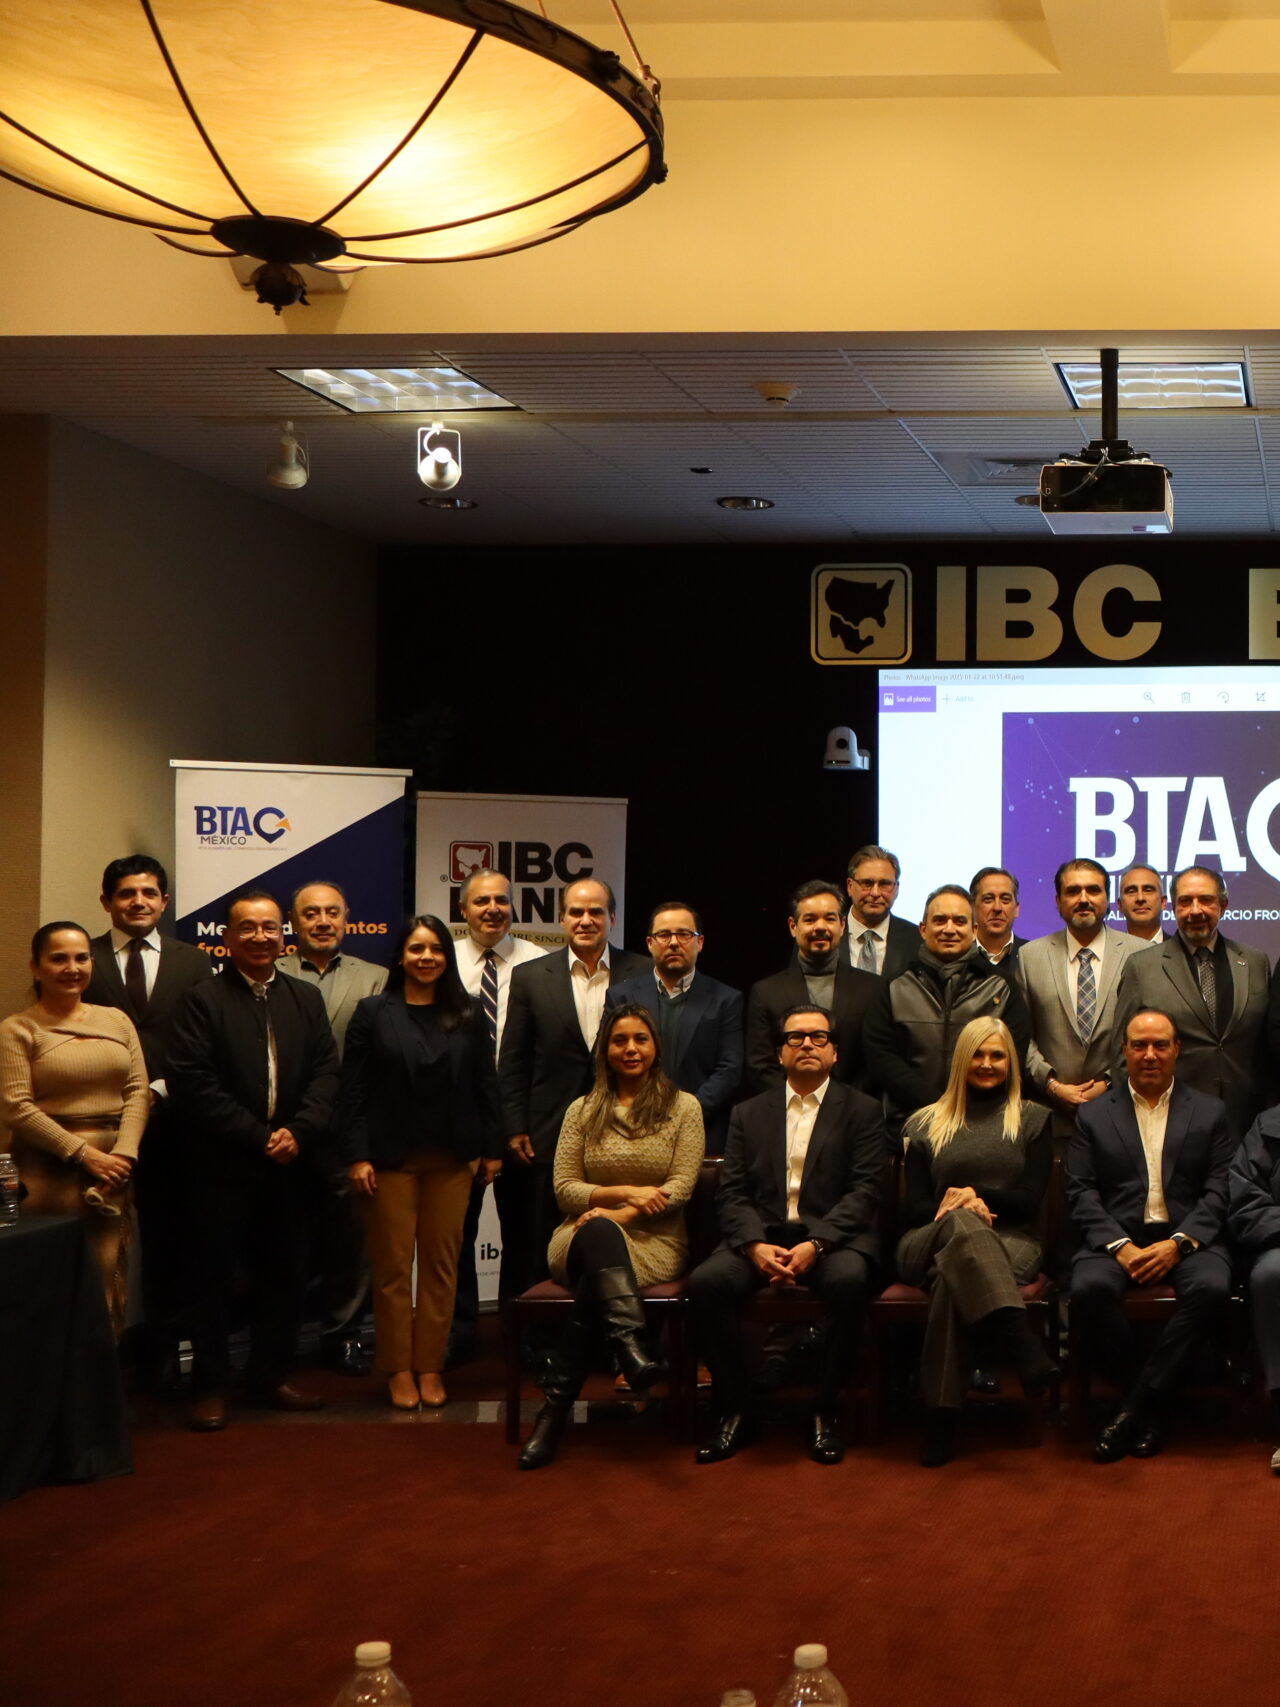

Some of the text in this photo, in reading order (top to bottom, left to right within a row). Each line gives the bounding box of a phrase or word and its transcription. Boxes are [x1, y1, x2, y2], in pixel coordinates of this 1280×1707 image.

[936, 565, 1163, 661] IBC
[913, 696, 931, 704] photos
[498, 841, 594, 883] IBC
